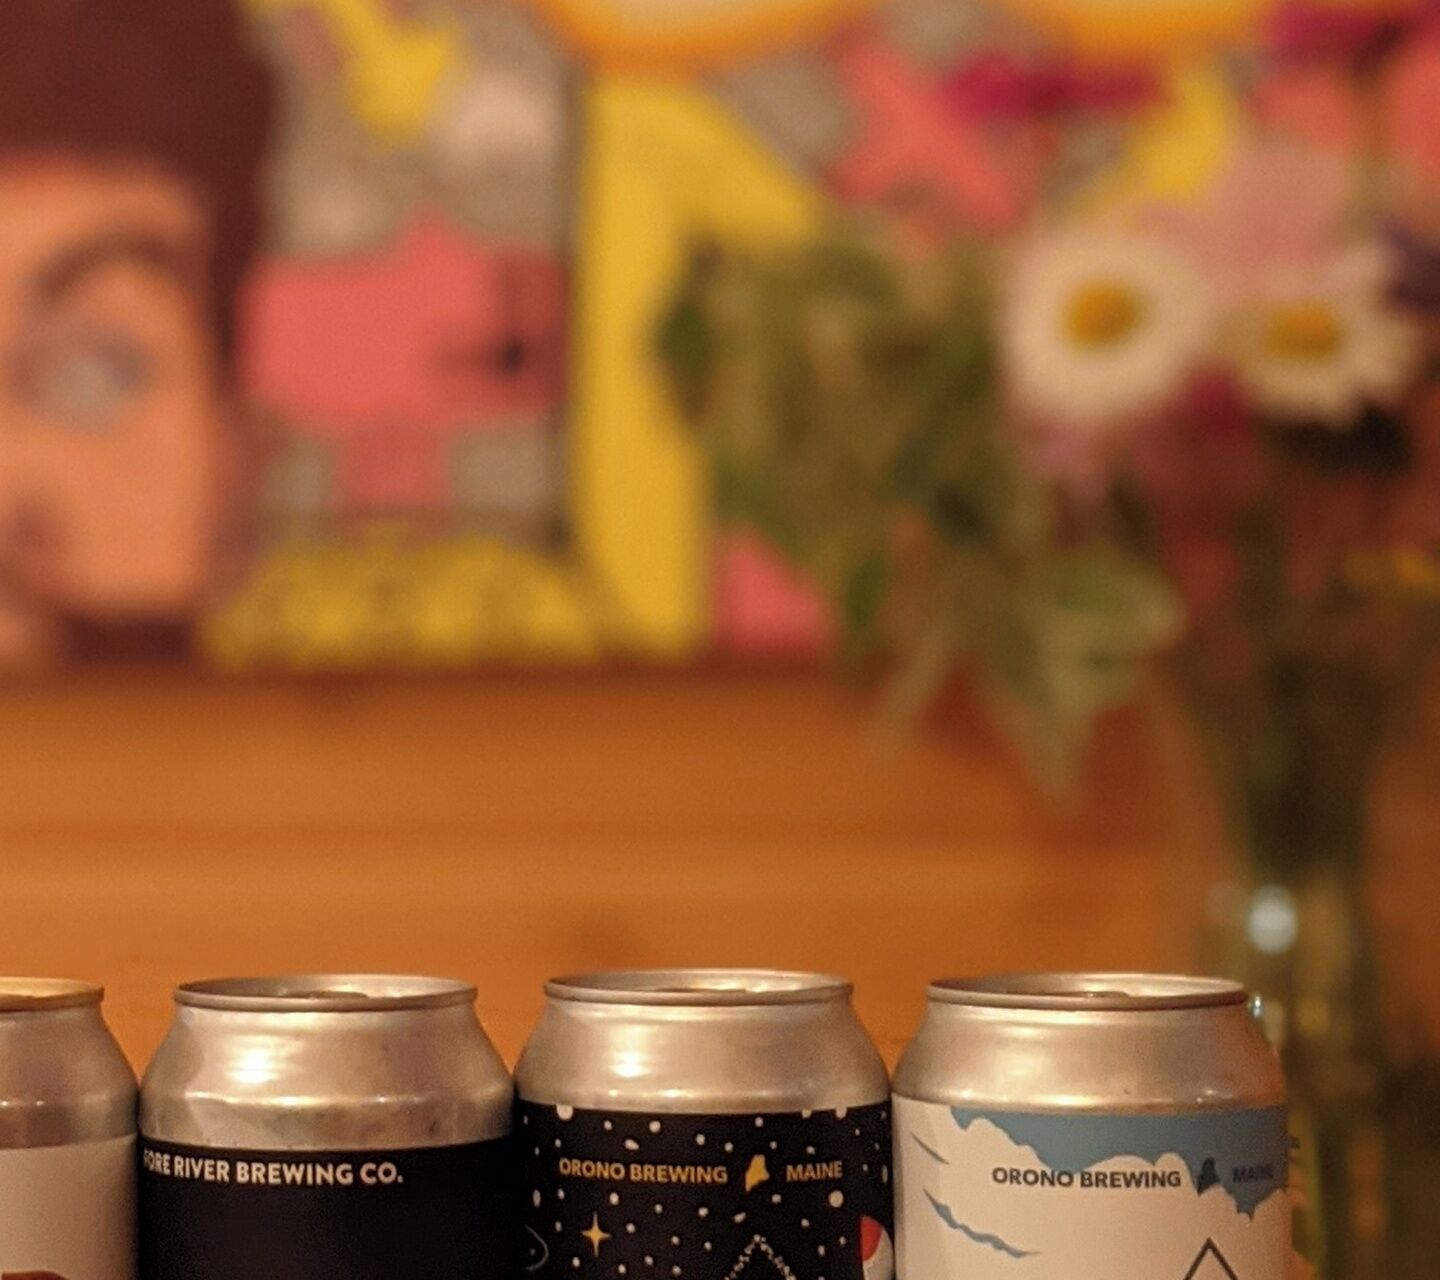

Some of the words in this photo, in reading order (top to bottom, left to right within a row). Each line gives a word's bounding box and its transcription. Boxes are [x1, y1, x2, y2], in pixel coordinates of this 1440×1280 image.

[174, 1156, 230, 1182] RIVER
[236, 1161, 354, 1186] BREWING
[360, 1162, 404, 1185] CO.
[559, 1157, 626, 1181] ORONO
[630, 1163, 728, 1184] BREWING
[786, 1160, 843, 1183] MAINE
[992, 1166, 1074, 1188] ORONO
[1080, 1168, 1182, 1190] BREWING
